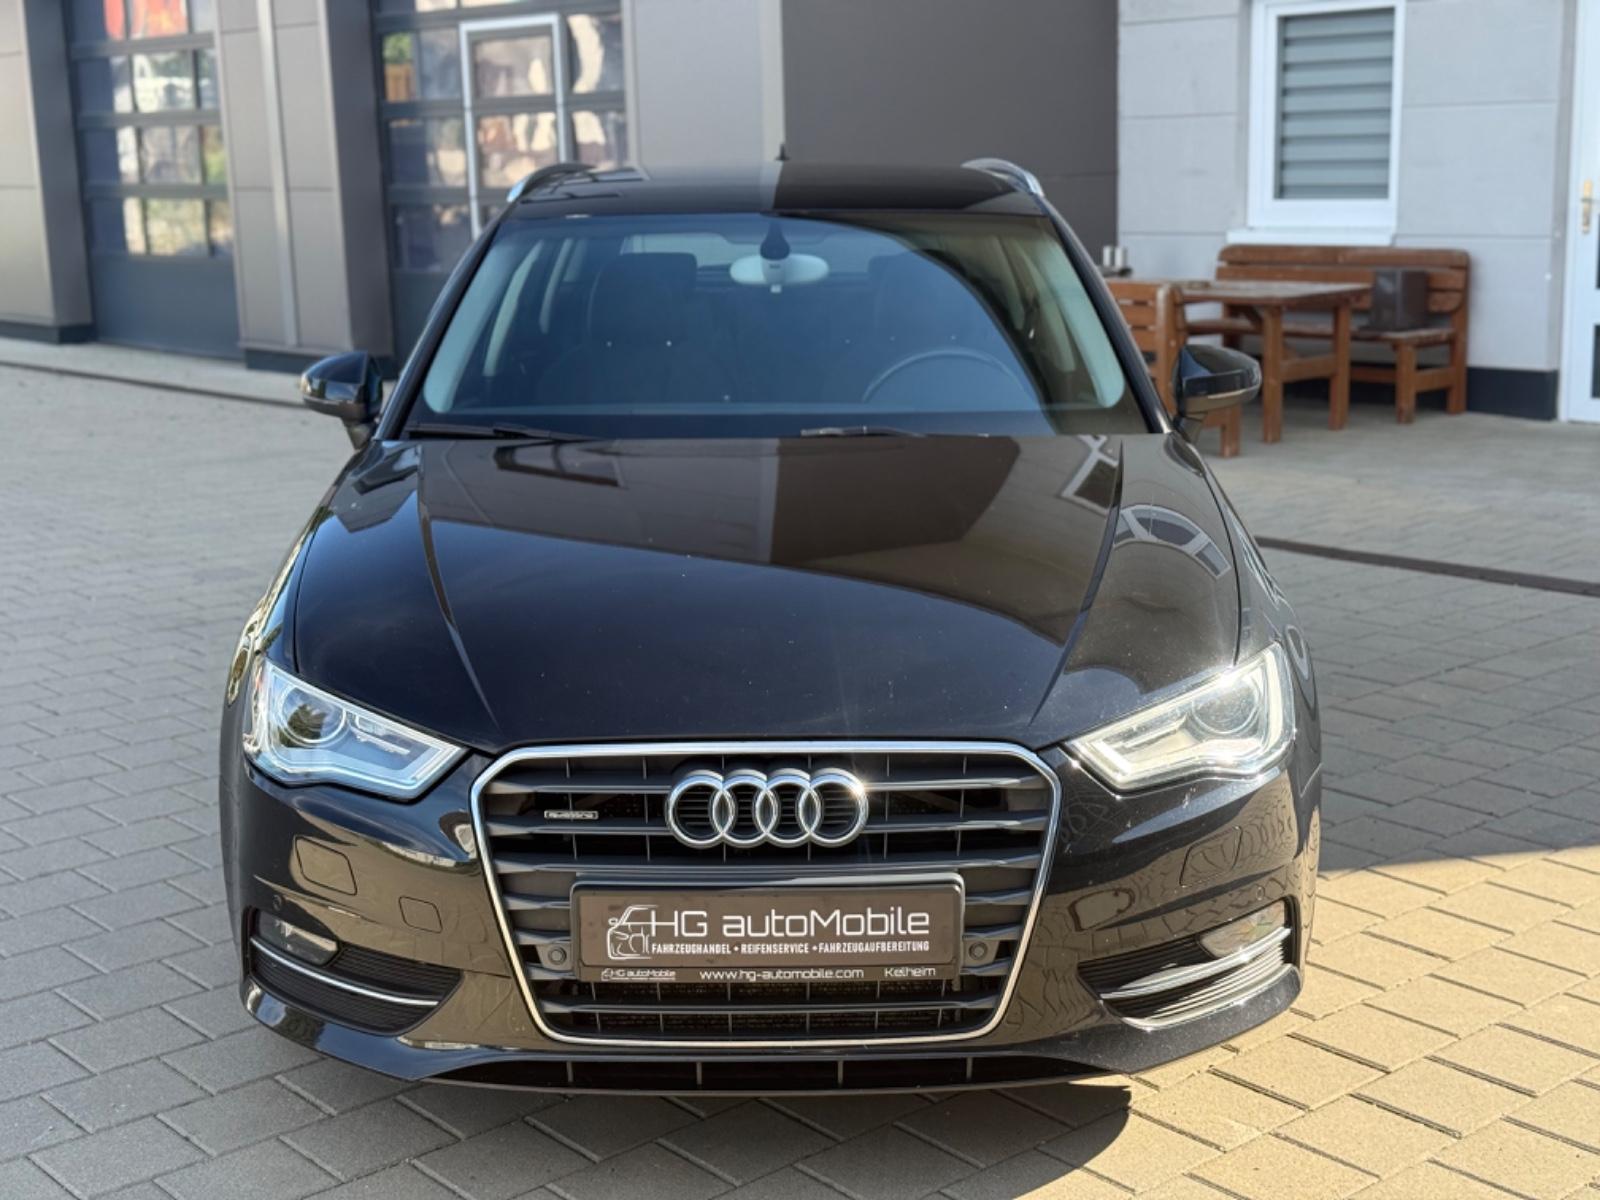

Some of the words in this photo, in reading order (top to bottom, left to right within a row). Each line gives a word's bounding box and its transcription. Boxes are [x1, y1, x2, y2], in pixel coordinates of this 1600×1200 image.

[651, 910, 708, 937] HG
[722, 906, 930, 938] autoMobile
[651, 943, 732, 955] FAHRZEUGHANDEL
[740, 942, 809, 955] REIFENSERVICE
[818, 940, 930, 954] FAHRZEUGAUFBEREITUNG
[699, 968, 865, 982] www.hg-automobile.com
[883, 966, 936, 977] Kelheim
